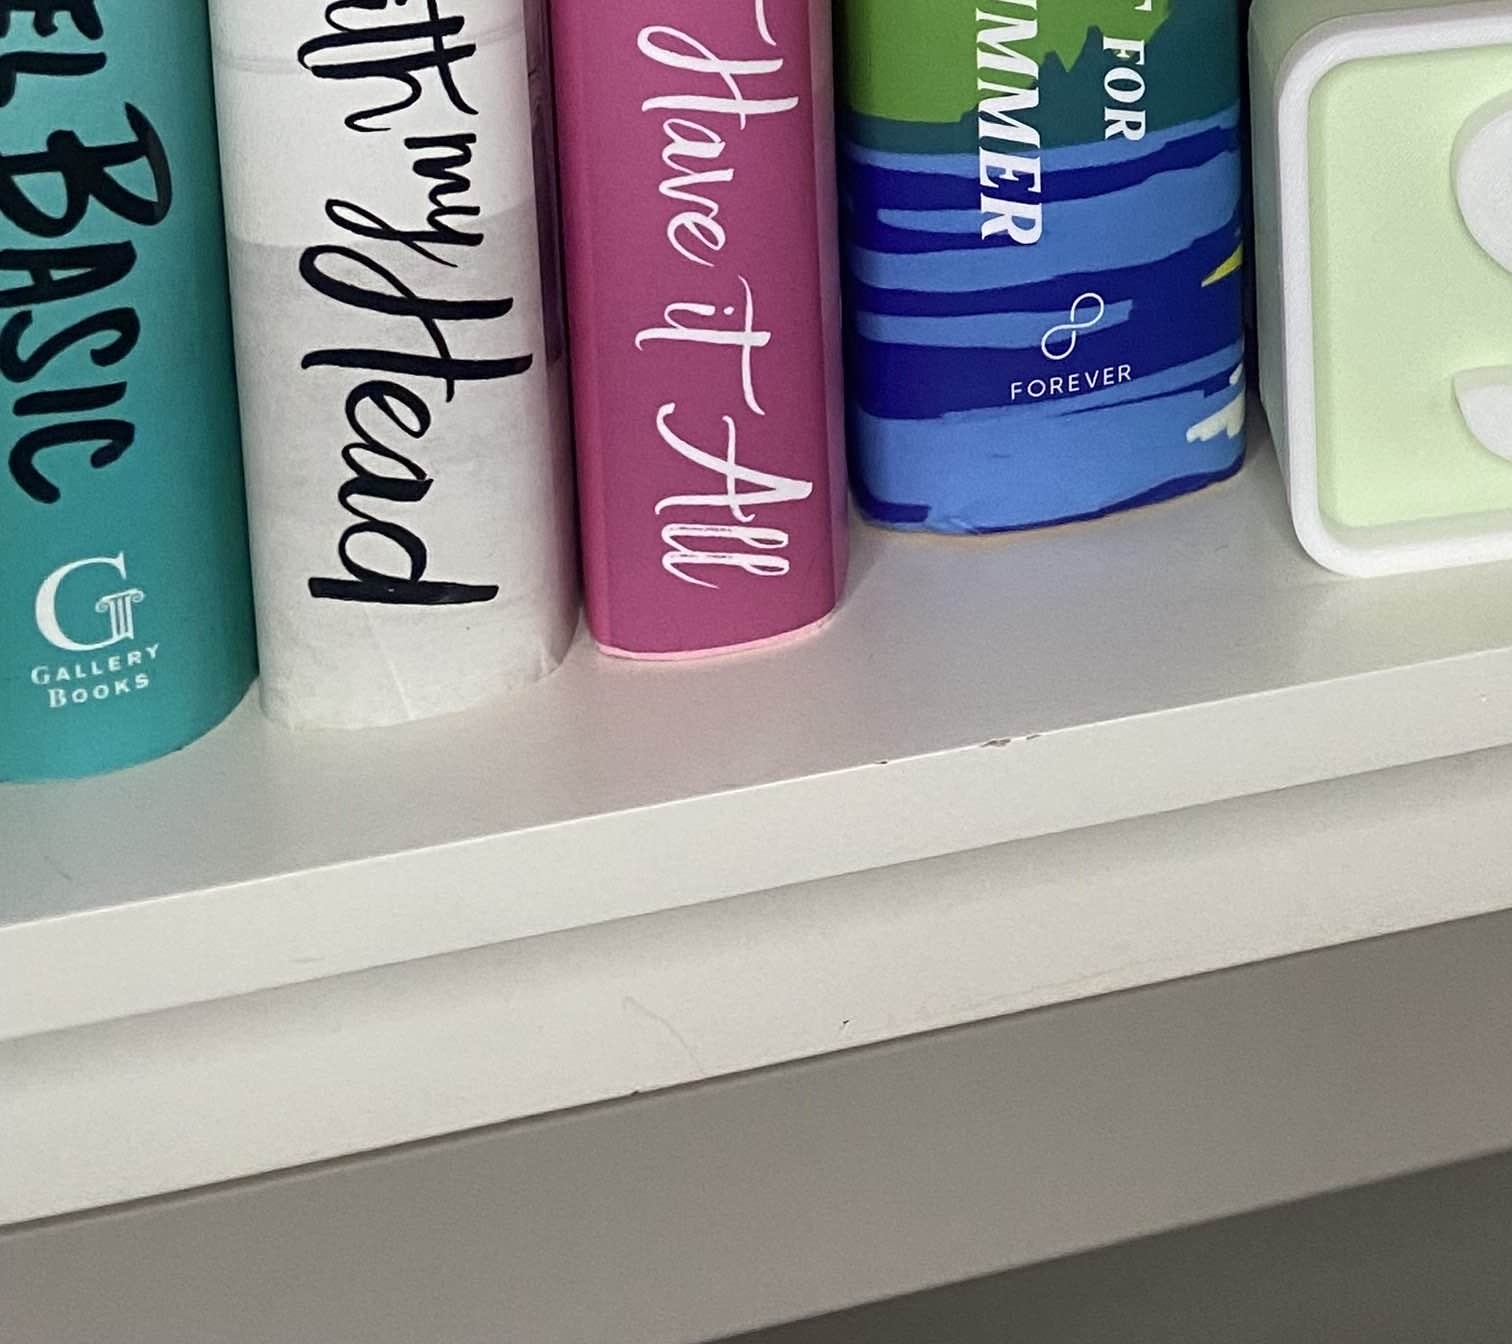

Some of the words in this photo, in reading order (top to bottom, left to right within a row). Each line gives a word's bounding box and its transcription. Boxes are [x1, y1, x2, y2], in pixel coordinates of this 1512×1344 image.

[636, 25, 800, 267] Have
[1104, 38, 1148, 142] FOR
[325, 133, 484, 268] my
[0, 102, 173, 505] BASIC
[634, 274, 772, 416] it
[300, 244, 534, 606] Head
[1010, 367, 1133, 400] FOREVER
[654, 402, 814, 590] All
[31, 643, 161, 685] GALLERY
[48, 673, 151, 708] BOOKS
